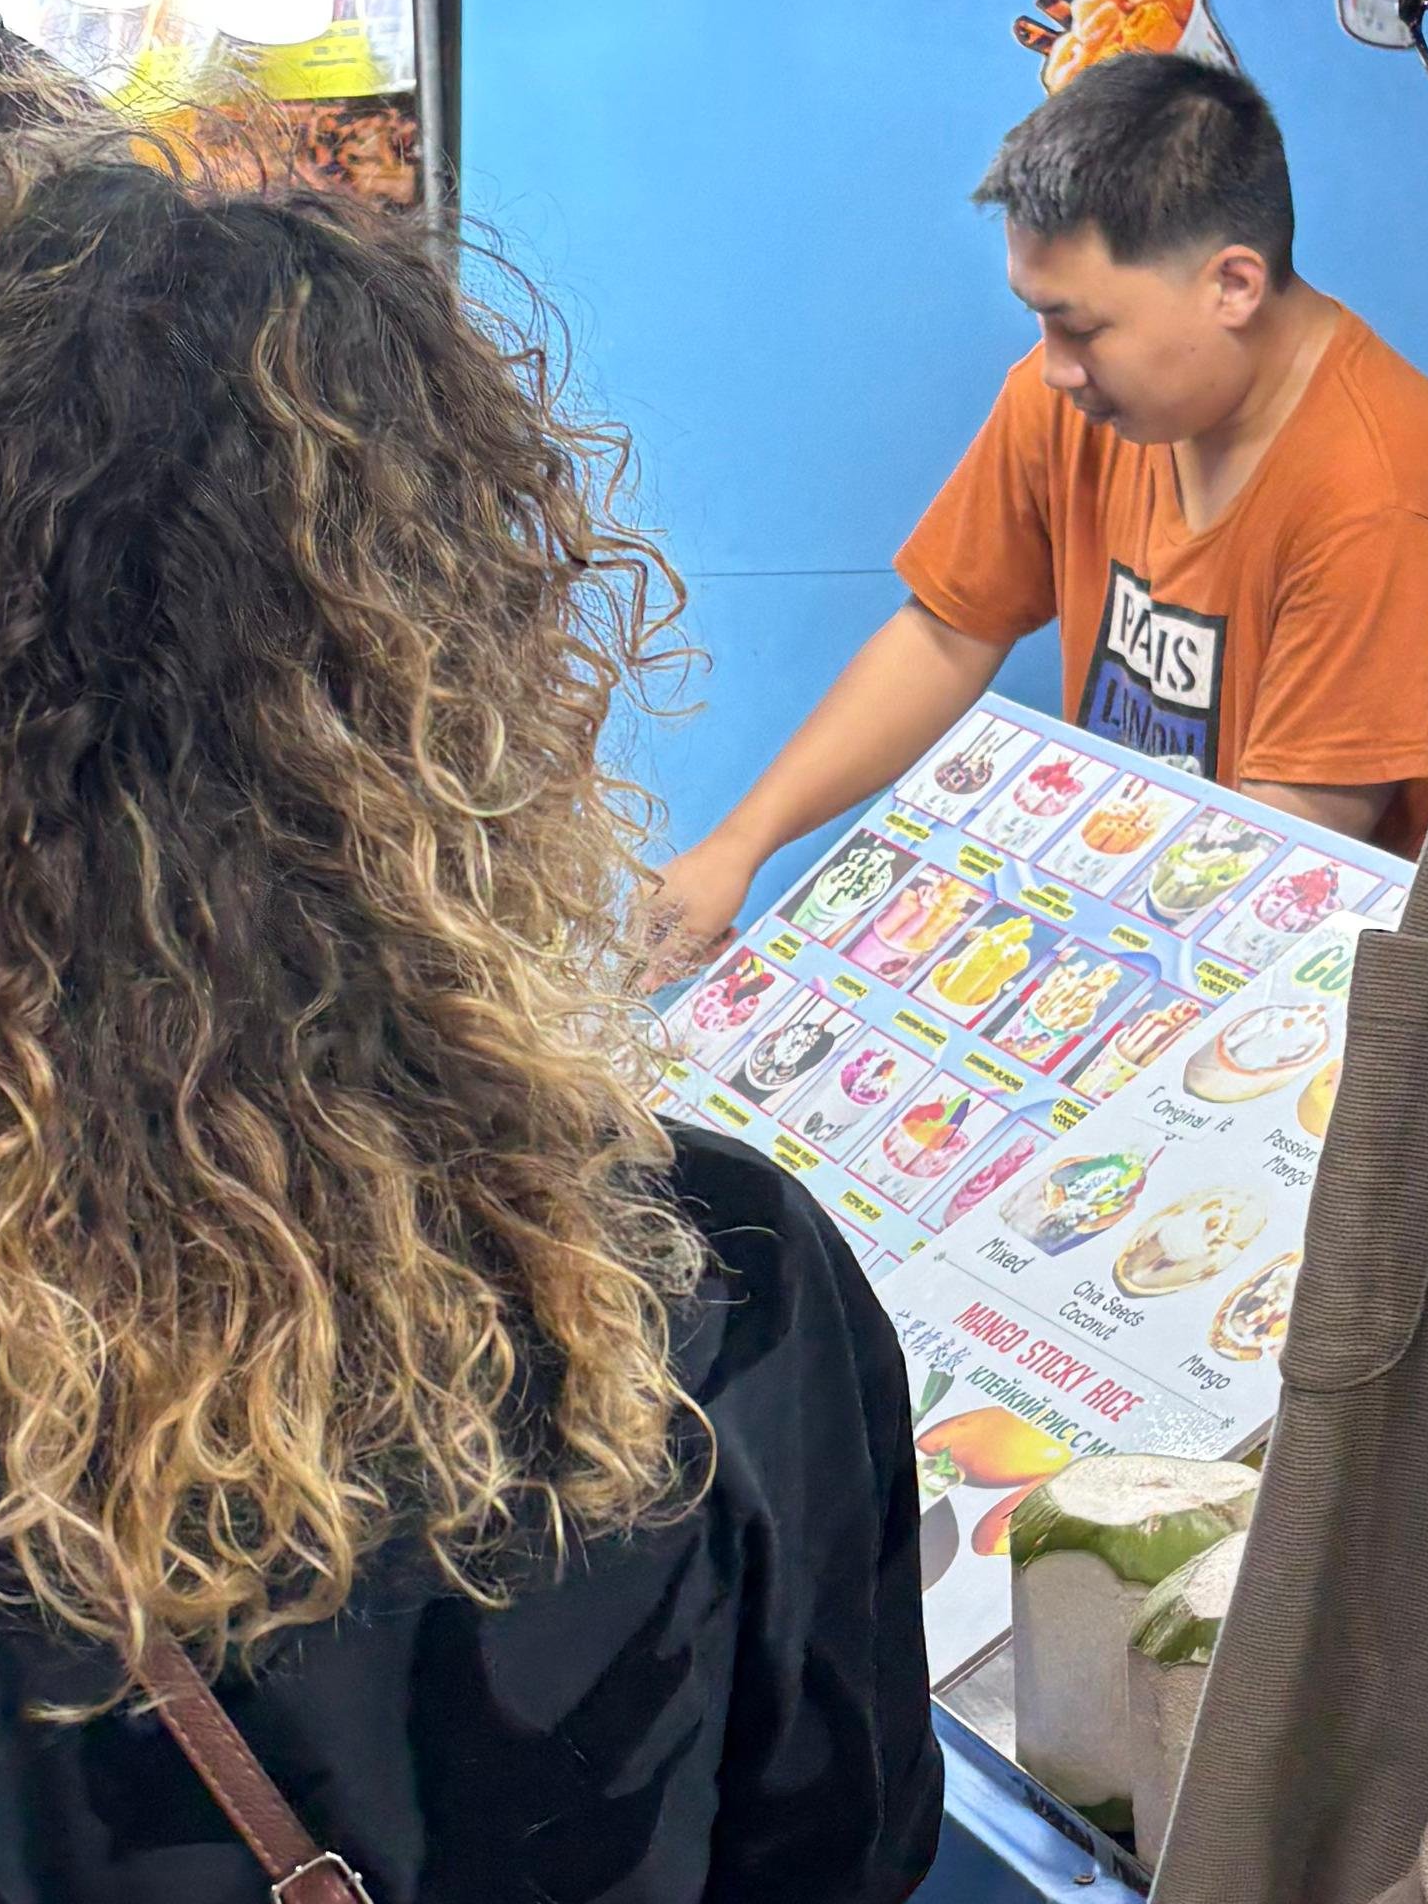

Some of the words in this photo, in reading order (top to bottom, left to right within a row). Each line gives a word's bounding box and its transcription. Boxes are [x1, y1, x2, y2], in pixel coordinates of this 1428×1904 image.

[1153, 1098, 1212, 1130] Original
[1262, 1127, 1319, 1163] Passion
[1261, 1154, 1313, 1188] Mango
[976, 1236, 1036, 1275] Mixed
[1058, 1301, 1120, 1342] Coconut
[1072, 1279, 1104, 1301] Chia
[1102, 1296, 1146, 1327] Seeds
[953, 1300, 1030, 1354] MANGO
[1015, 1339, 1099, 1394] STICKY
[1080, 1377, 1145, 1424] RICE
[1177, 1353, 1232, 1391] Mango
[964, 1364, 1052, 1420] КЛЕЙКИЙ
[1036, 1410, 1079, 1442] РИС
